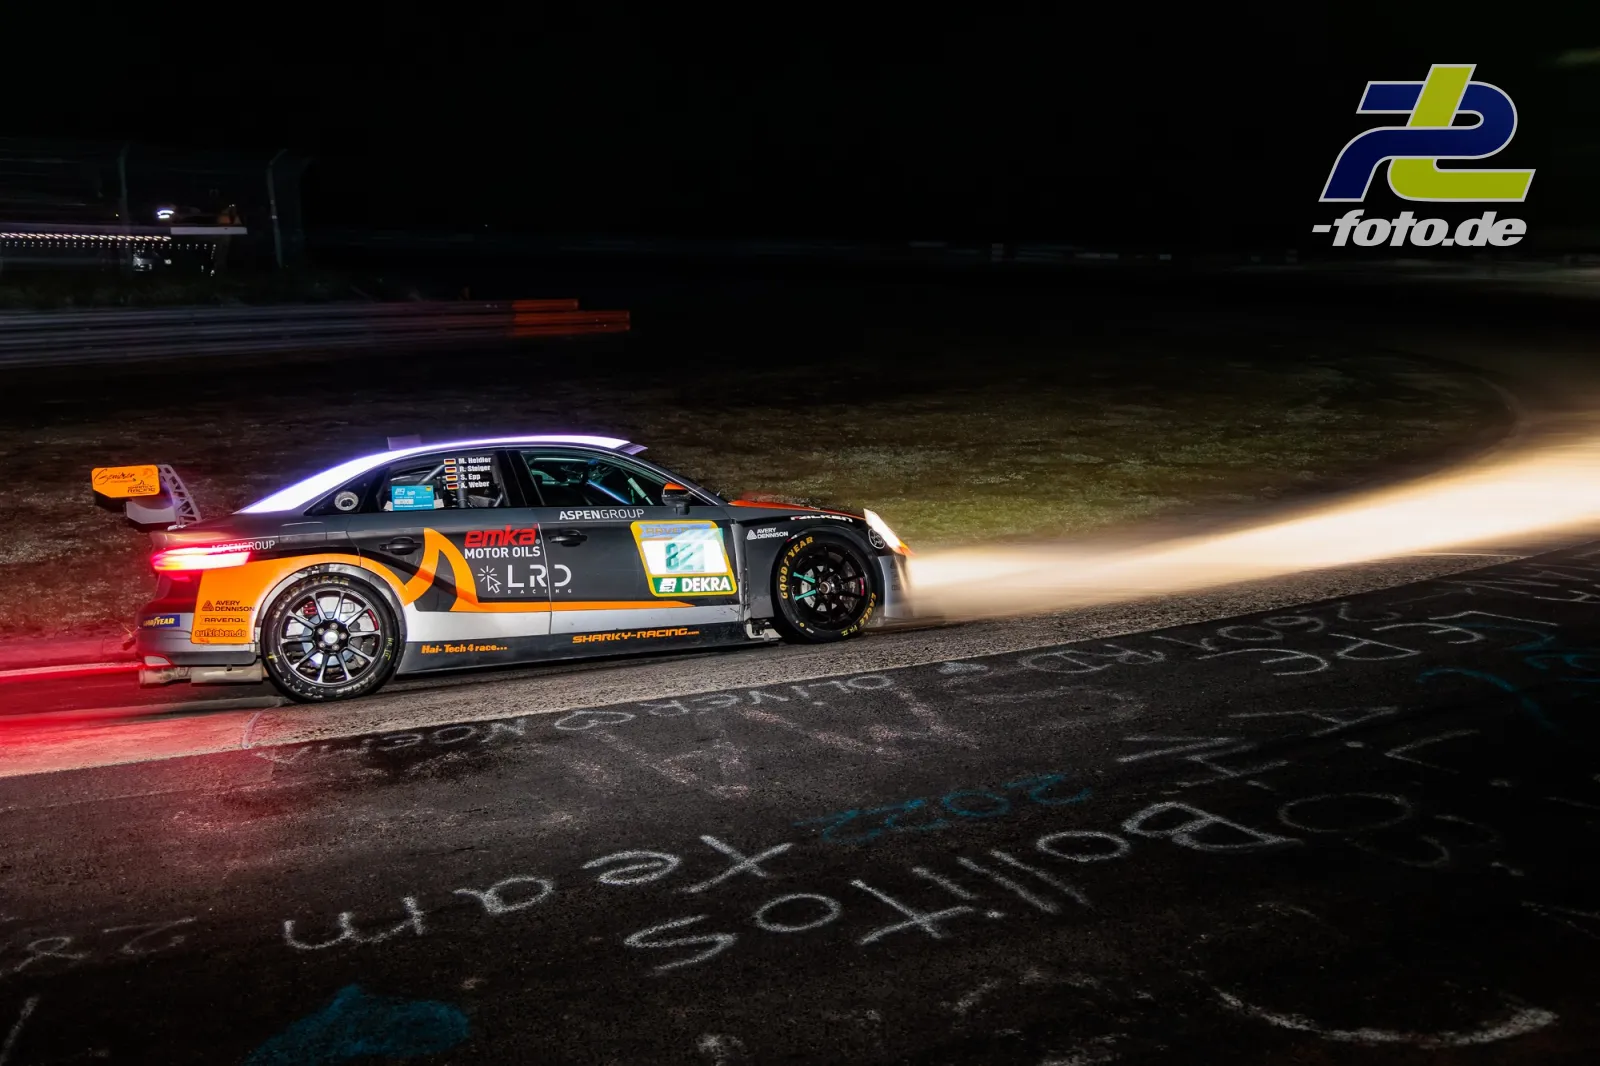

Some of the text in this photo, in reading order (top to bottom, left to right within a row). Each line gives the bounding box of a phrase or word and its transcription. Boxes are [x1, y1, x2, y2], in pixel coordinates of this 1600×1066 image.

[559, 508, 645, 521] ASPENGROUP
[757, 531, 788, 539] DENNISON
[465, 546, 541, 559] MOTOR OILS
[508, 564, 572, 588] LRD
[682, 577, 731, 592] DEKRA
[195, 628, 247, 638] aufkleben.de
[443, 643, 466, 653] Tech
[467, 643, 474, 652] 4
